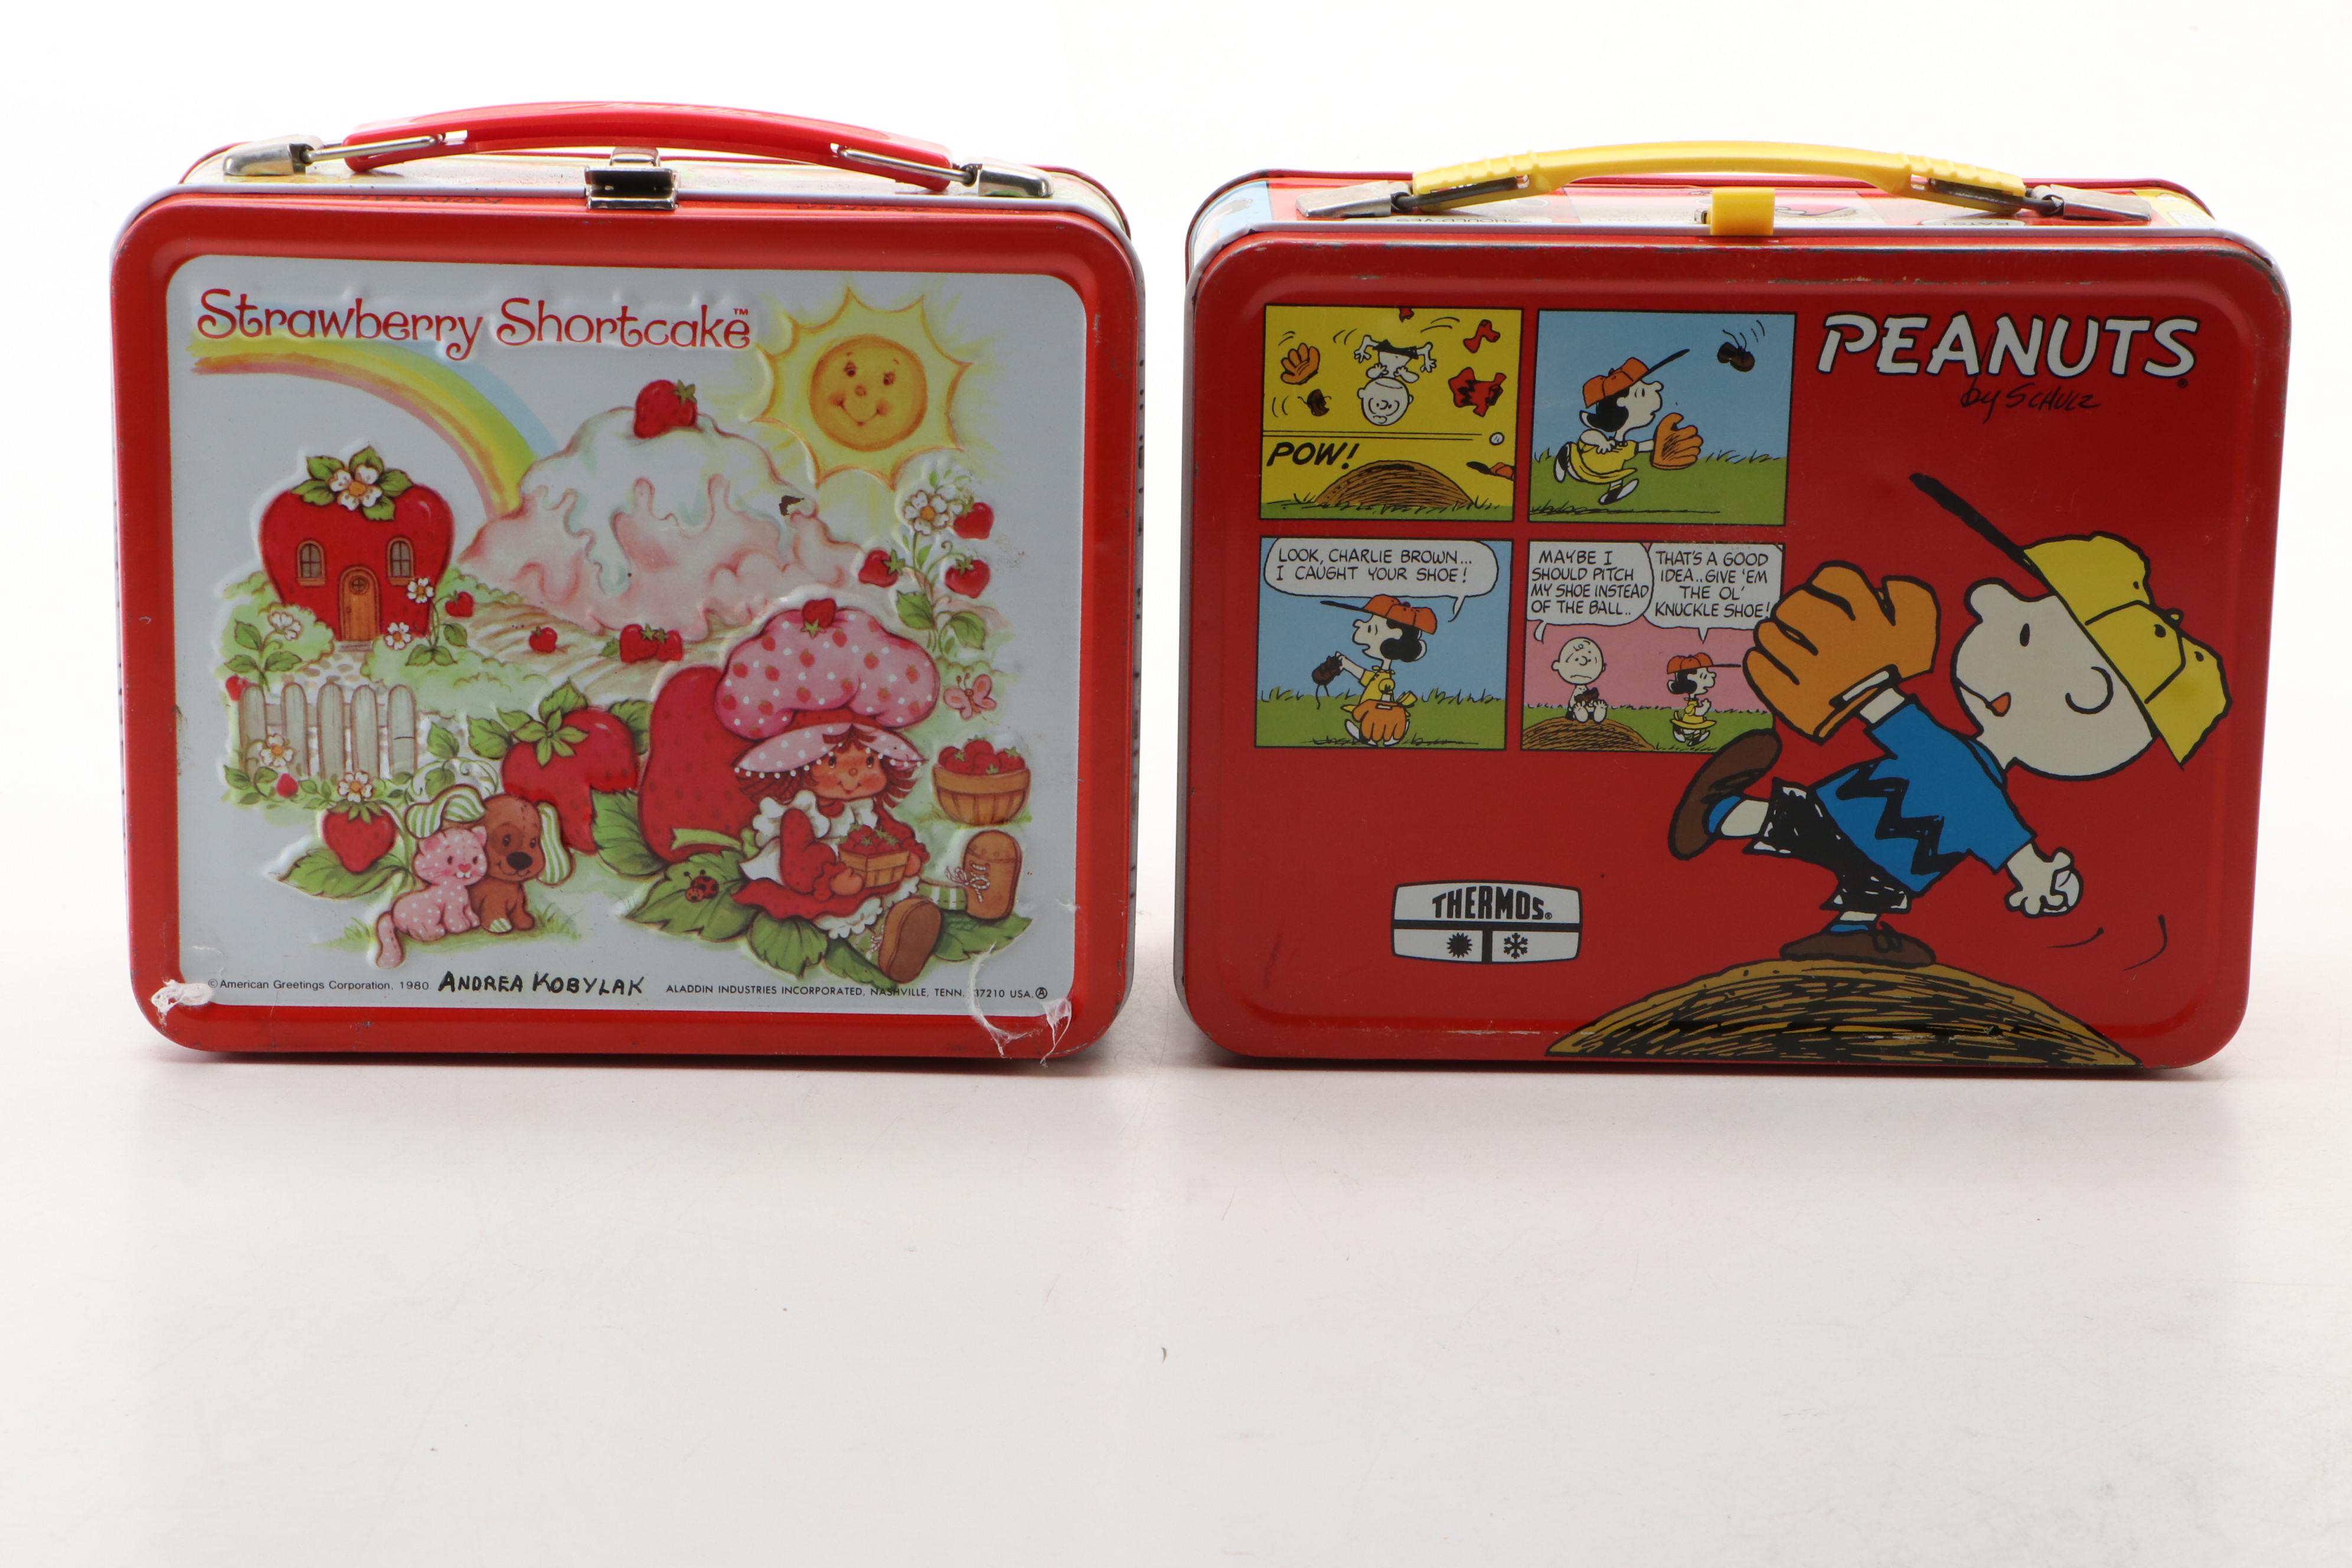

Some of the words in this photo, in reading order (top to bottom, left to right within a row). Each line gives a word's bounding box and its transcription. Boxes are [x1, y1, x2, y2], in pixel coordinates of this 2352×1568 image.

[198, 289, 484, 360] Strawberry
[1817, 311, 2200, 378] PEANUTS
[1266, 442, 1360, 469] POW!
[1278, 548, 1324, 565] LOOK,
[1329, 548, 1392, 563] CHARLIE
[1401, 550, 1471, 564] BROWN...
[1539, 550, 1596, 564] MAYBE
[1604, 551, 1612, 565] I
[1655, 551, 1702, 566] THAT'S
[1707, 551, 1717, 566] A
[1723, 552, 1768, 566] GOOD
[1276, 565, 1283, 580] I
[1295, 567, 1358, 580] CAUGHT
[1368, 567, 1407, 580] YOUR
[1417, 567, 1466, 583] SHOE!
[1532, 567, 1587, 581] SHOULD
[1593, 568, 1634, 582] PITCH
[1743, 569, 1767, 583] 'EM
[1531, 583, 1552, 596] MY
[1556, 584, 1590, 597] SHOE
[1595, 584, 1649, 598] INSTEAD
[1680, 586, 1710, 599] THE
[1719, 586, 1745, 600] OL'
[1531, 600, 1551, 613] OF
[1557, 600, 1583, 614] THE
[1589, 600, 1631, 615] BALL..
[1655, 602, 1719, 617] KNUCKLE
[1724, 602, 1770, 619] SHOE!
[273, 980, 324, 991] Greetings
[329, 981, 393, 991] Corporation,
[400, 981, 429, 990] 1980
[438, 971, 522, 992] ANDREA
[533, 972, 644, 996] KOBYLAK
[667, 985, 713, 993] ALADDIN
[718, 985, 776, 994] INDUSTRIES
[782, 985, 865, 996] INCORPORATED,
[871, 988, 929, 997] NASHVILLE,
[935, 988, 965, 997] TENN.
